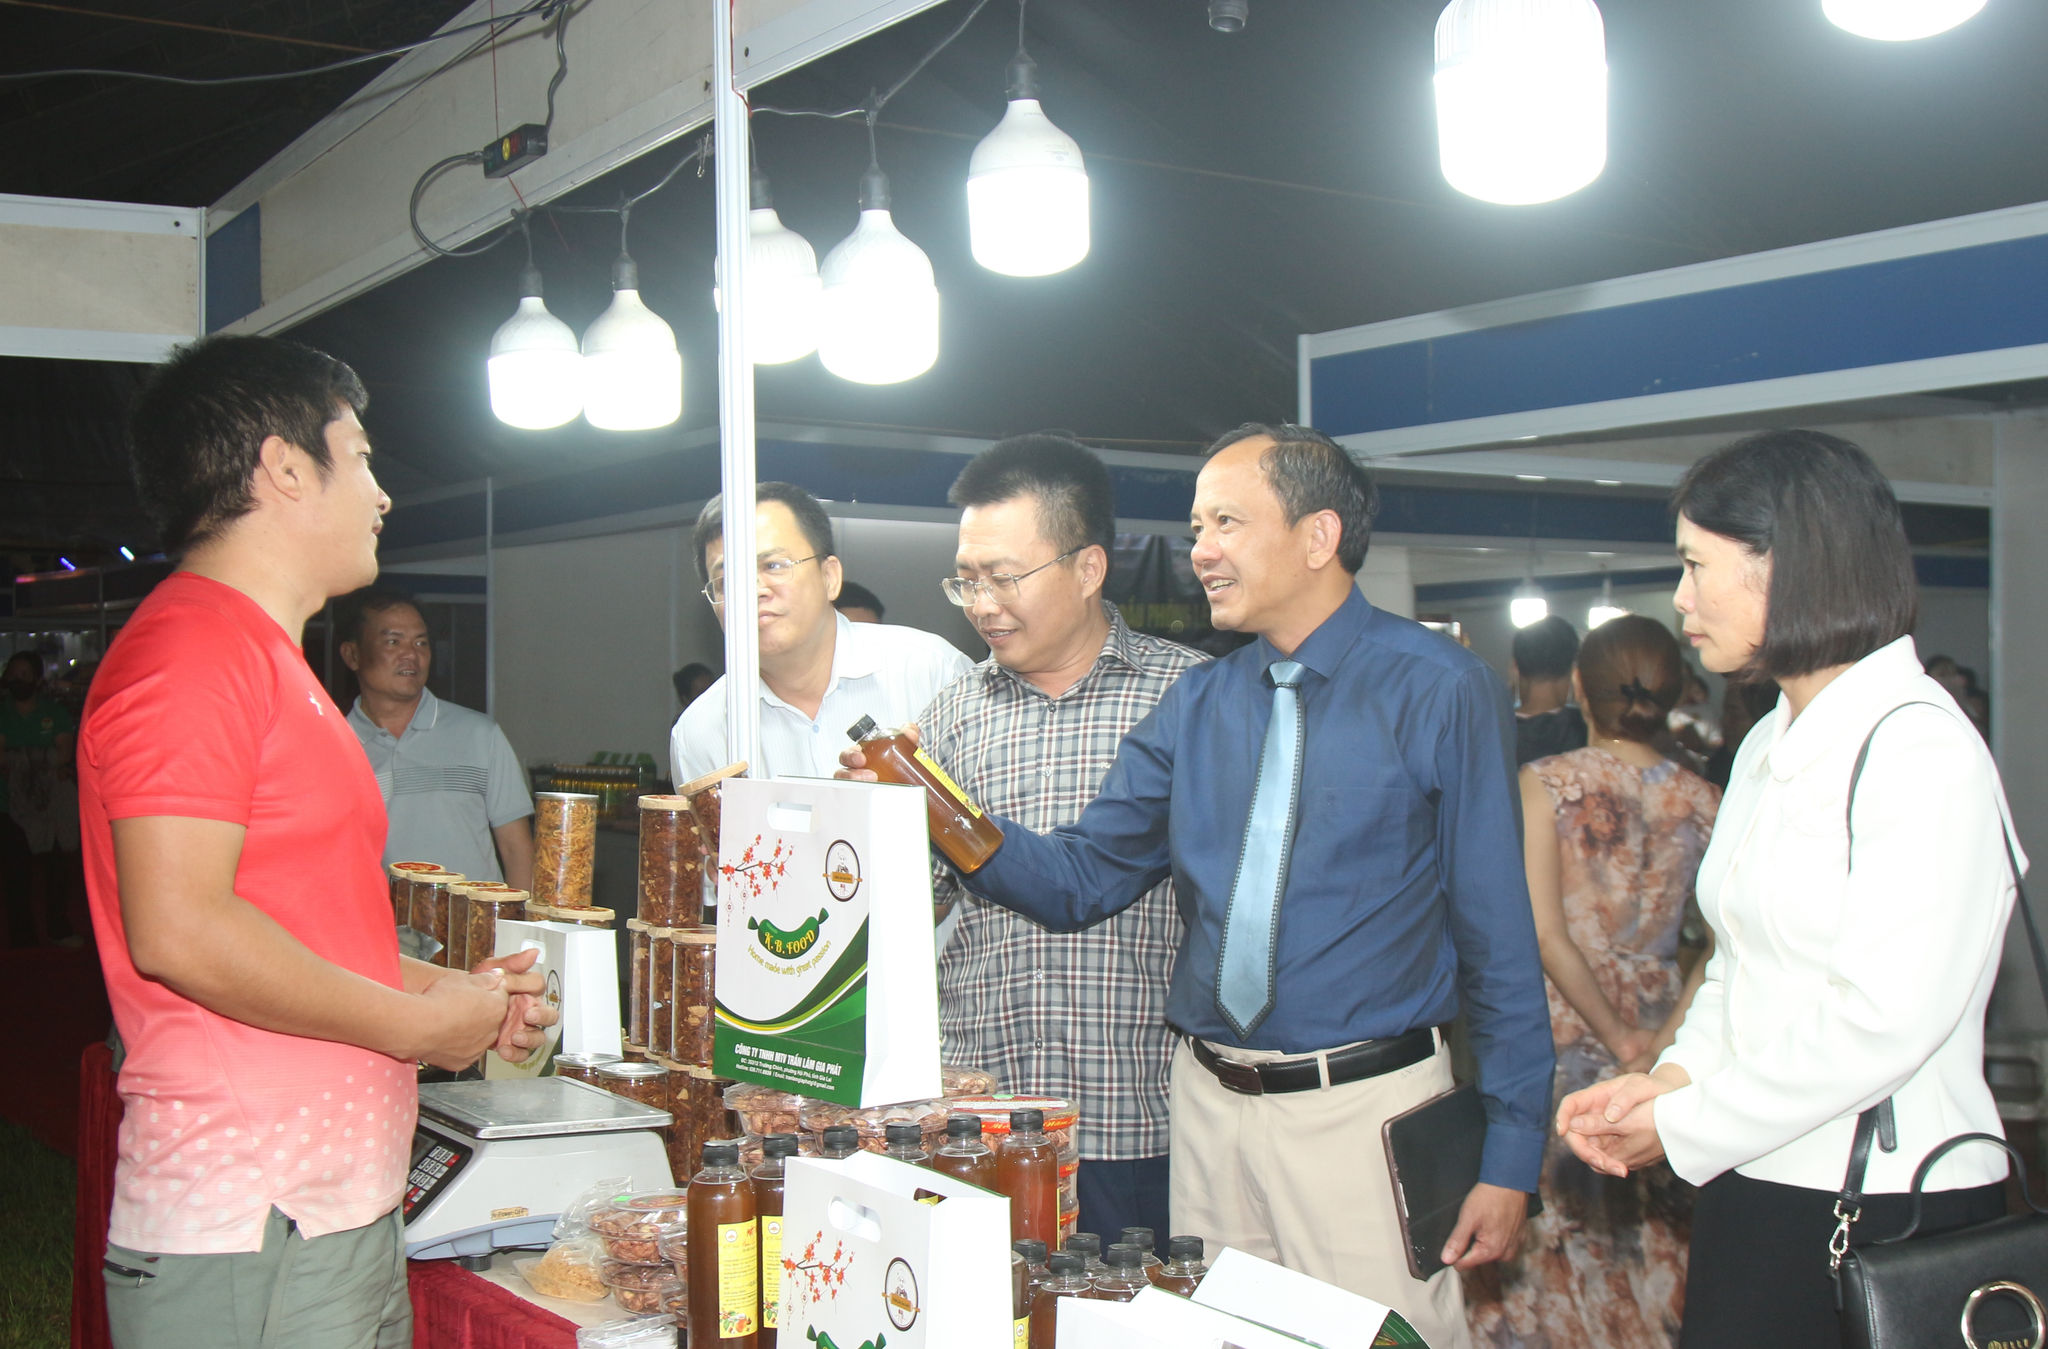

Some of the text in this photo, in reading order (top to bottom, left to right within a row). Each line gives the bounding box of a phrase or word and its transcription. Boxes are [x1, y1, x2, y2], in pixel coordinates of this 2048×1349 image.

[786, 930, 815, 954] FOOD
[748, 944, 764, 966] Home
[765, 961, 780, 974] made
[781, 965, 795, 975] with
[751, 1047, 758, 1058] TY
